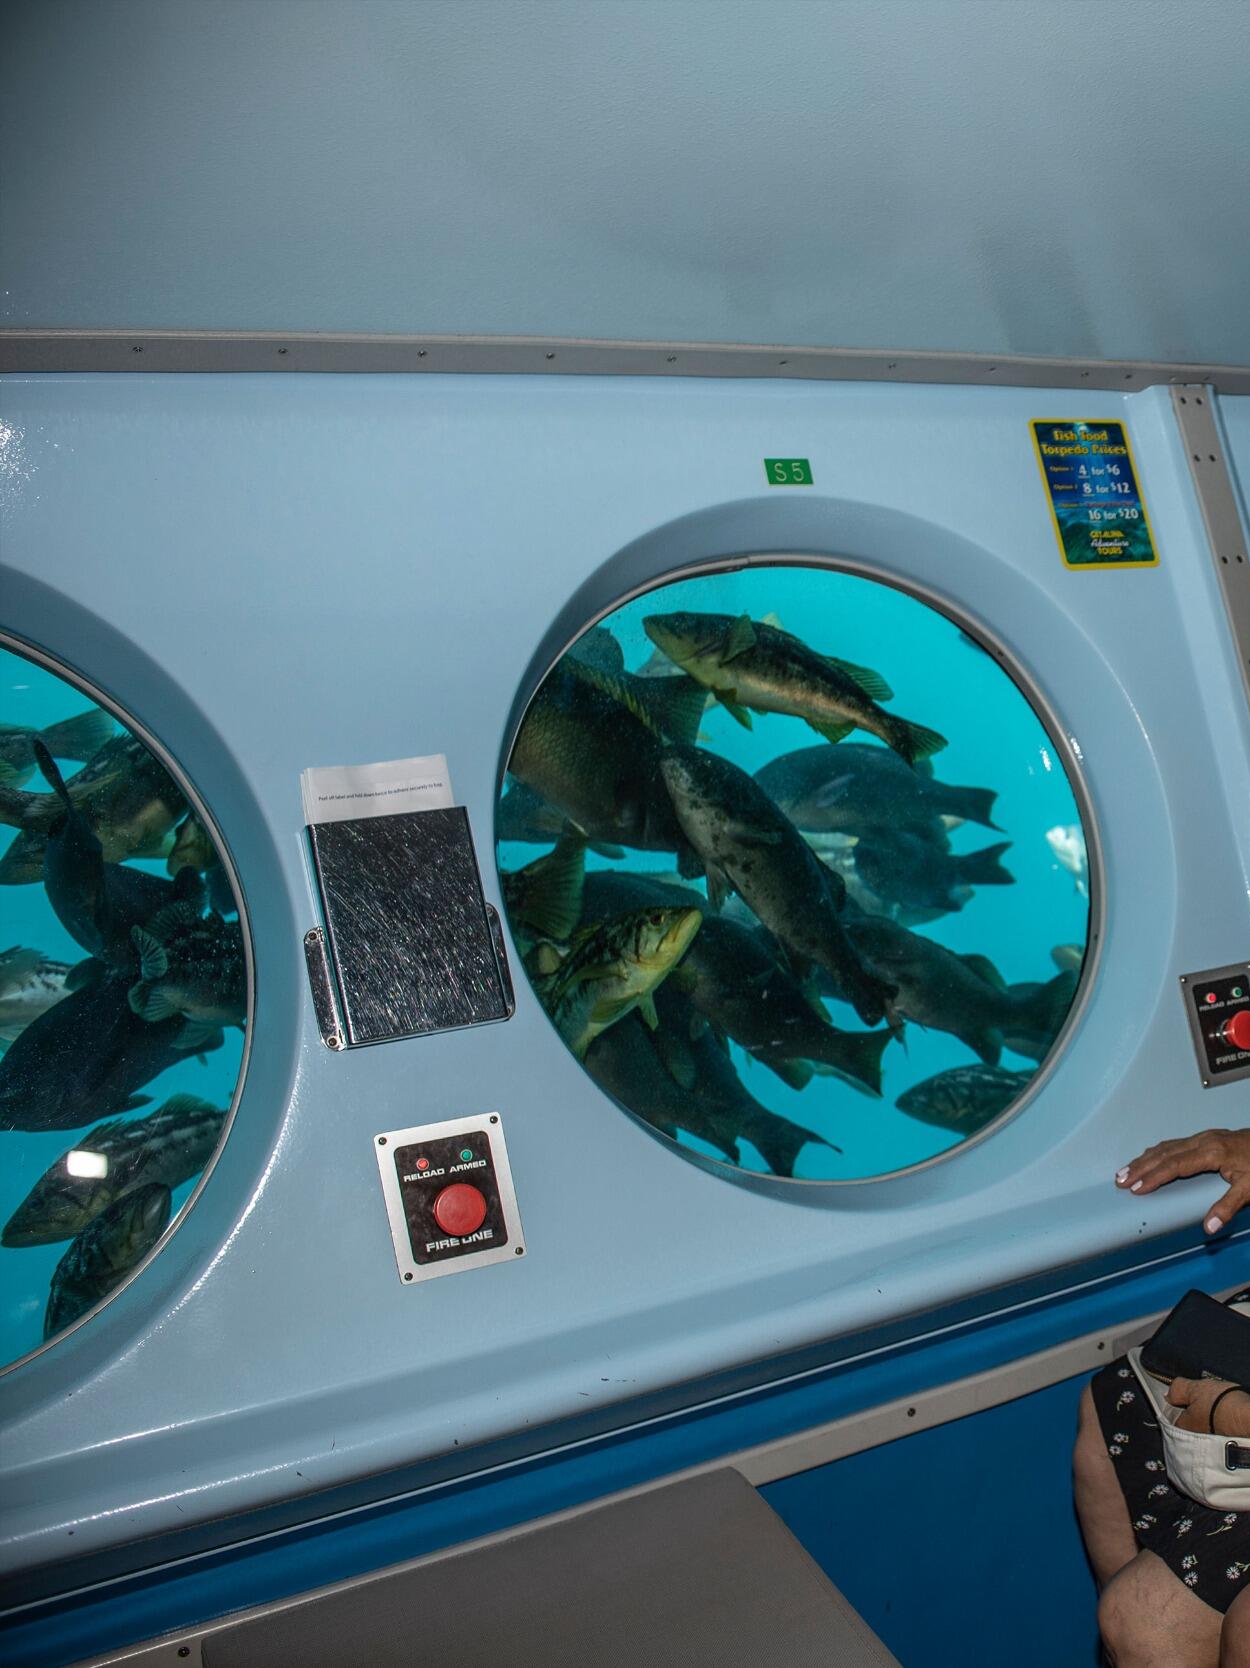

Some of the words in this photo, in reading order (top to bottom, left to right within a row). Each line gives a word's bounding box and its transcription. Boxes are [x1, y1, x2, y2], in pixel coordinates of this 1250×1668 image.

[1041, 444, 1089, 457] Torpedo
[1092, 445, 1127, 456] Prices
[1078, 464, 1087, 475] 4
[1091, 465, 1104, 475] for
[1106, 464, 1120, 475] $6
[1083, 483, 1092, 493] 8
[1096, 483, 1109, 493] for
[1111, 482, 1130, 493] $12
[1088, 510, 1101, 519] 16
[1104, 510, 1116, 519] for
[1119, 509, 1139, 519] $20
[1216, 1054, 1237, 1066] FIRE
[403, 1168, 445, 1182] RELOAD
[450, 1159, 487, 1173] ARMED
[425, 1237, 460, 1252] FIRE
